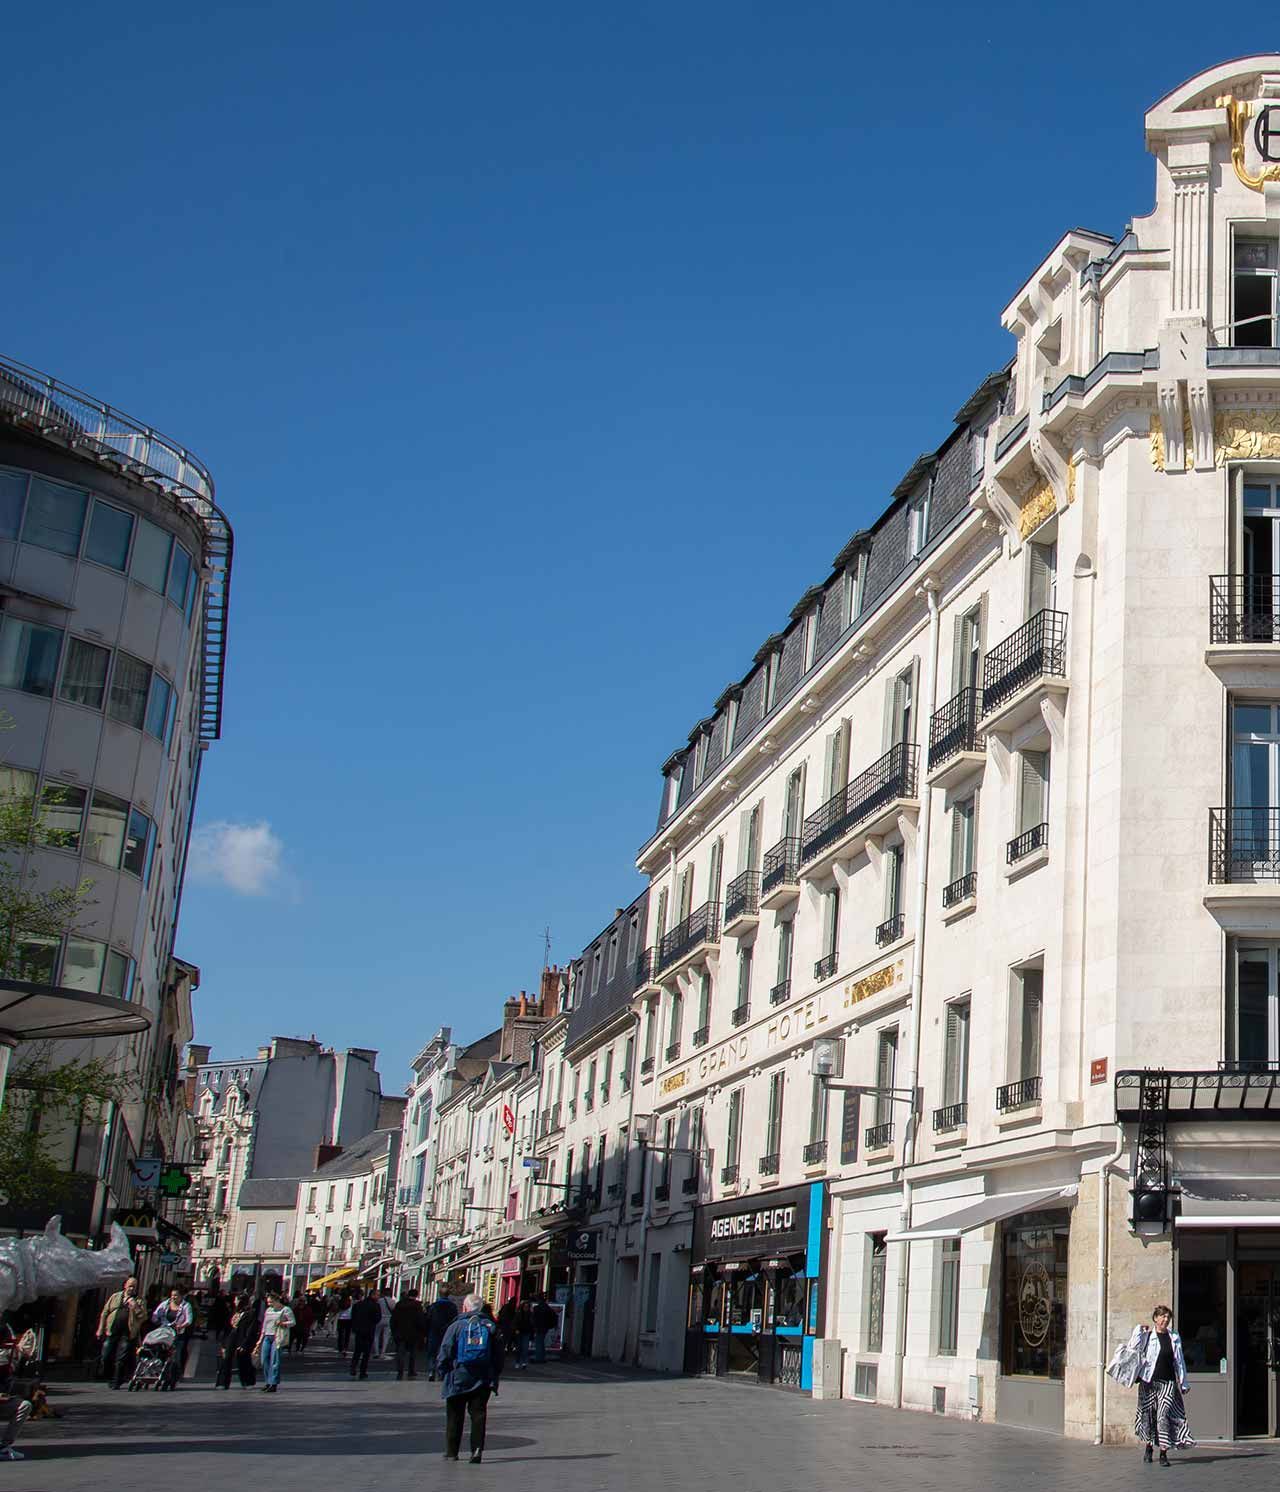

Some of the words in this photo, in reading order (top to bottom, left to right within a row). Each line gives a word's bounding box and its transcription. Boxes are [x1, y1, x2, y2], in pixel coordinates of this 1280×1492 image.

[699, 1035, 749, 1080] GRAND
[767, 997, 828, 1048] HOTEL
[711, 1214, 750, 1238] AGENCE
[754, 1207, 793, 1232] AFICO
